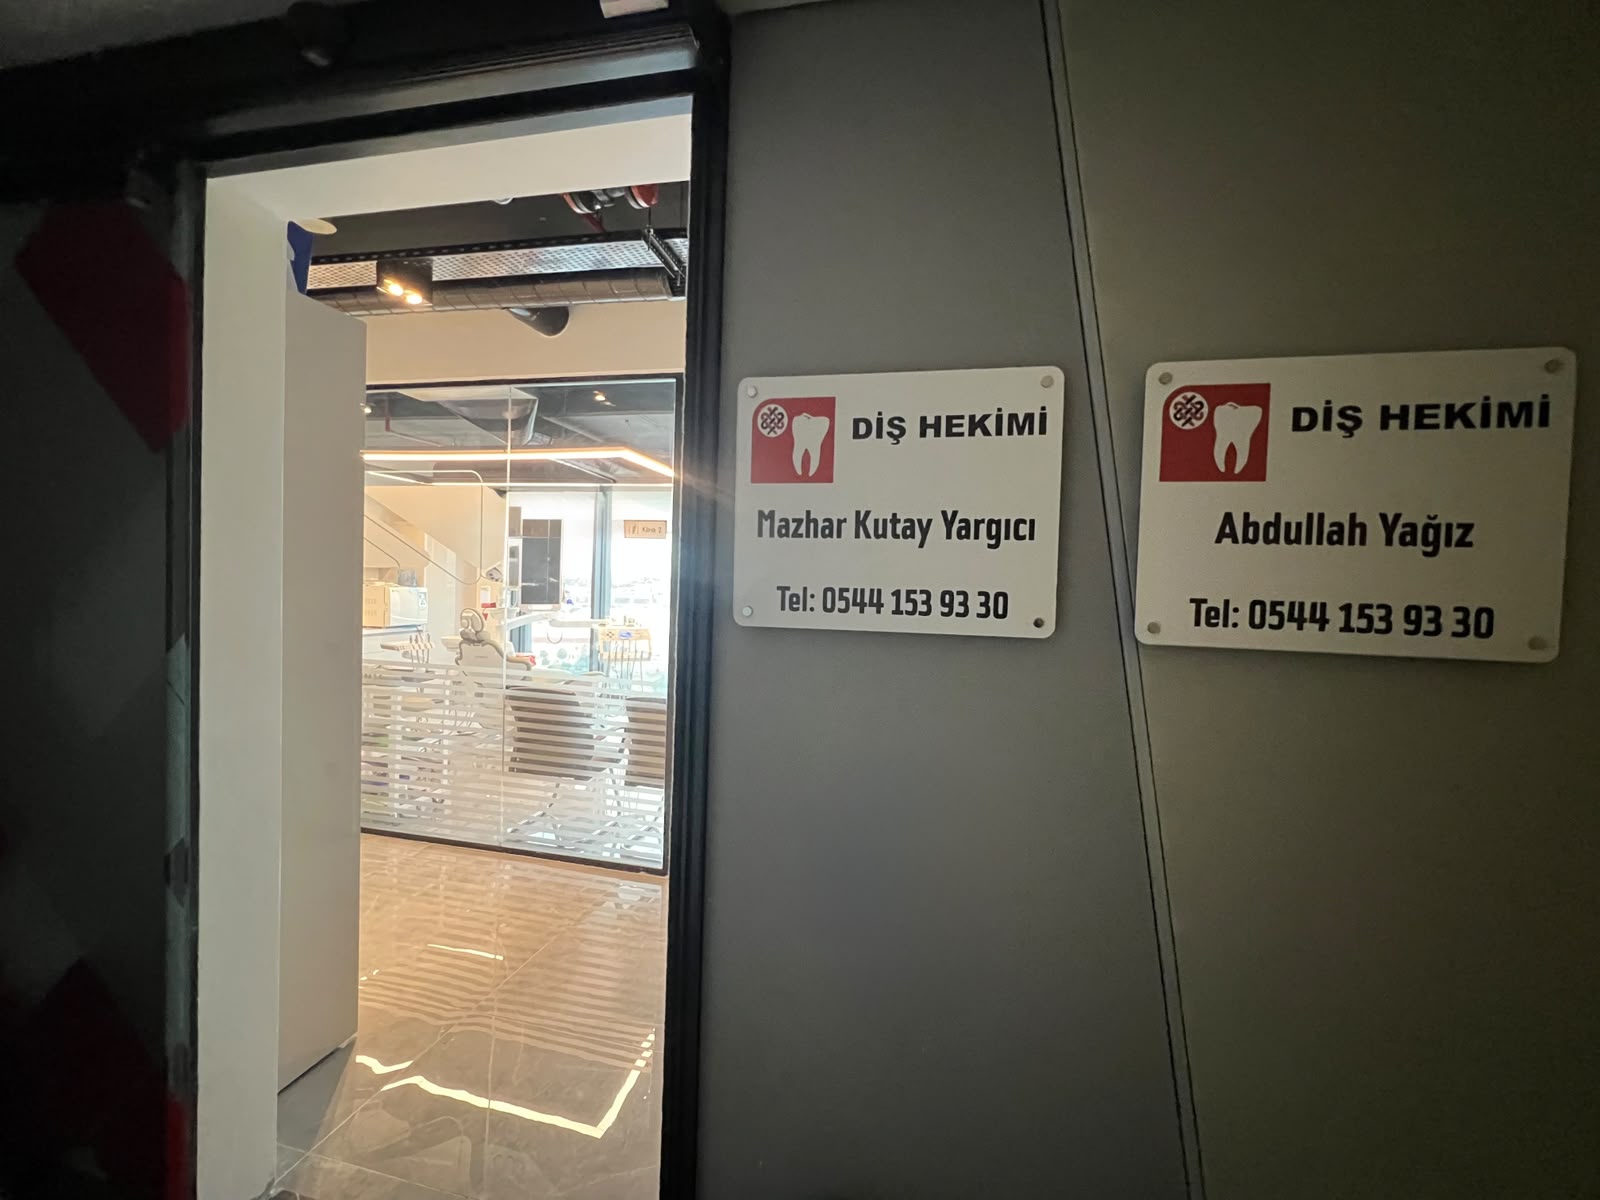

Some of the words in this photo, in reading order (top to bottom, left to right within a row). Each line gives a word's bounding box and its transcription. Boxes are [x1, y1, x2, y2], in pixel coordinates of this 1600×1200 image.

[852, 411, 907, 445] DİŞ
[919, 405, 1048, 439] HEKİMİ
[1291, 399, 1363, 439] DİŞ
[1380, 393, 1550, 432] HEKİMİ
[757, 509, 847, 540] Mazhar
[854, 510, 933, 549] Kutay
[941, 510, 1036, 550] Yargıcı
[1214, 511, 1368, 547] Abdullah
[1378, 512, 1475, 558] Yağız
[776, 585, 815, 613] Tel:
[822, 586, 884, 615] 0544
[891, 588, 932, 617] 153
[939, 589, 970, 618] 93
[976, 590, 1009, 620] 30
[1189, 597, 1240, 629] Tel:
[1248, 599, 1329, 632] 0544
[1338, 602, 1393, 635] 153
[1402, 604, 1443, 637] 93
[1450, 605, 1495, 640] 30
